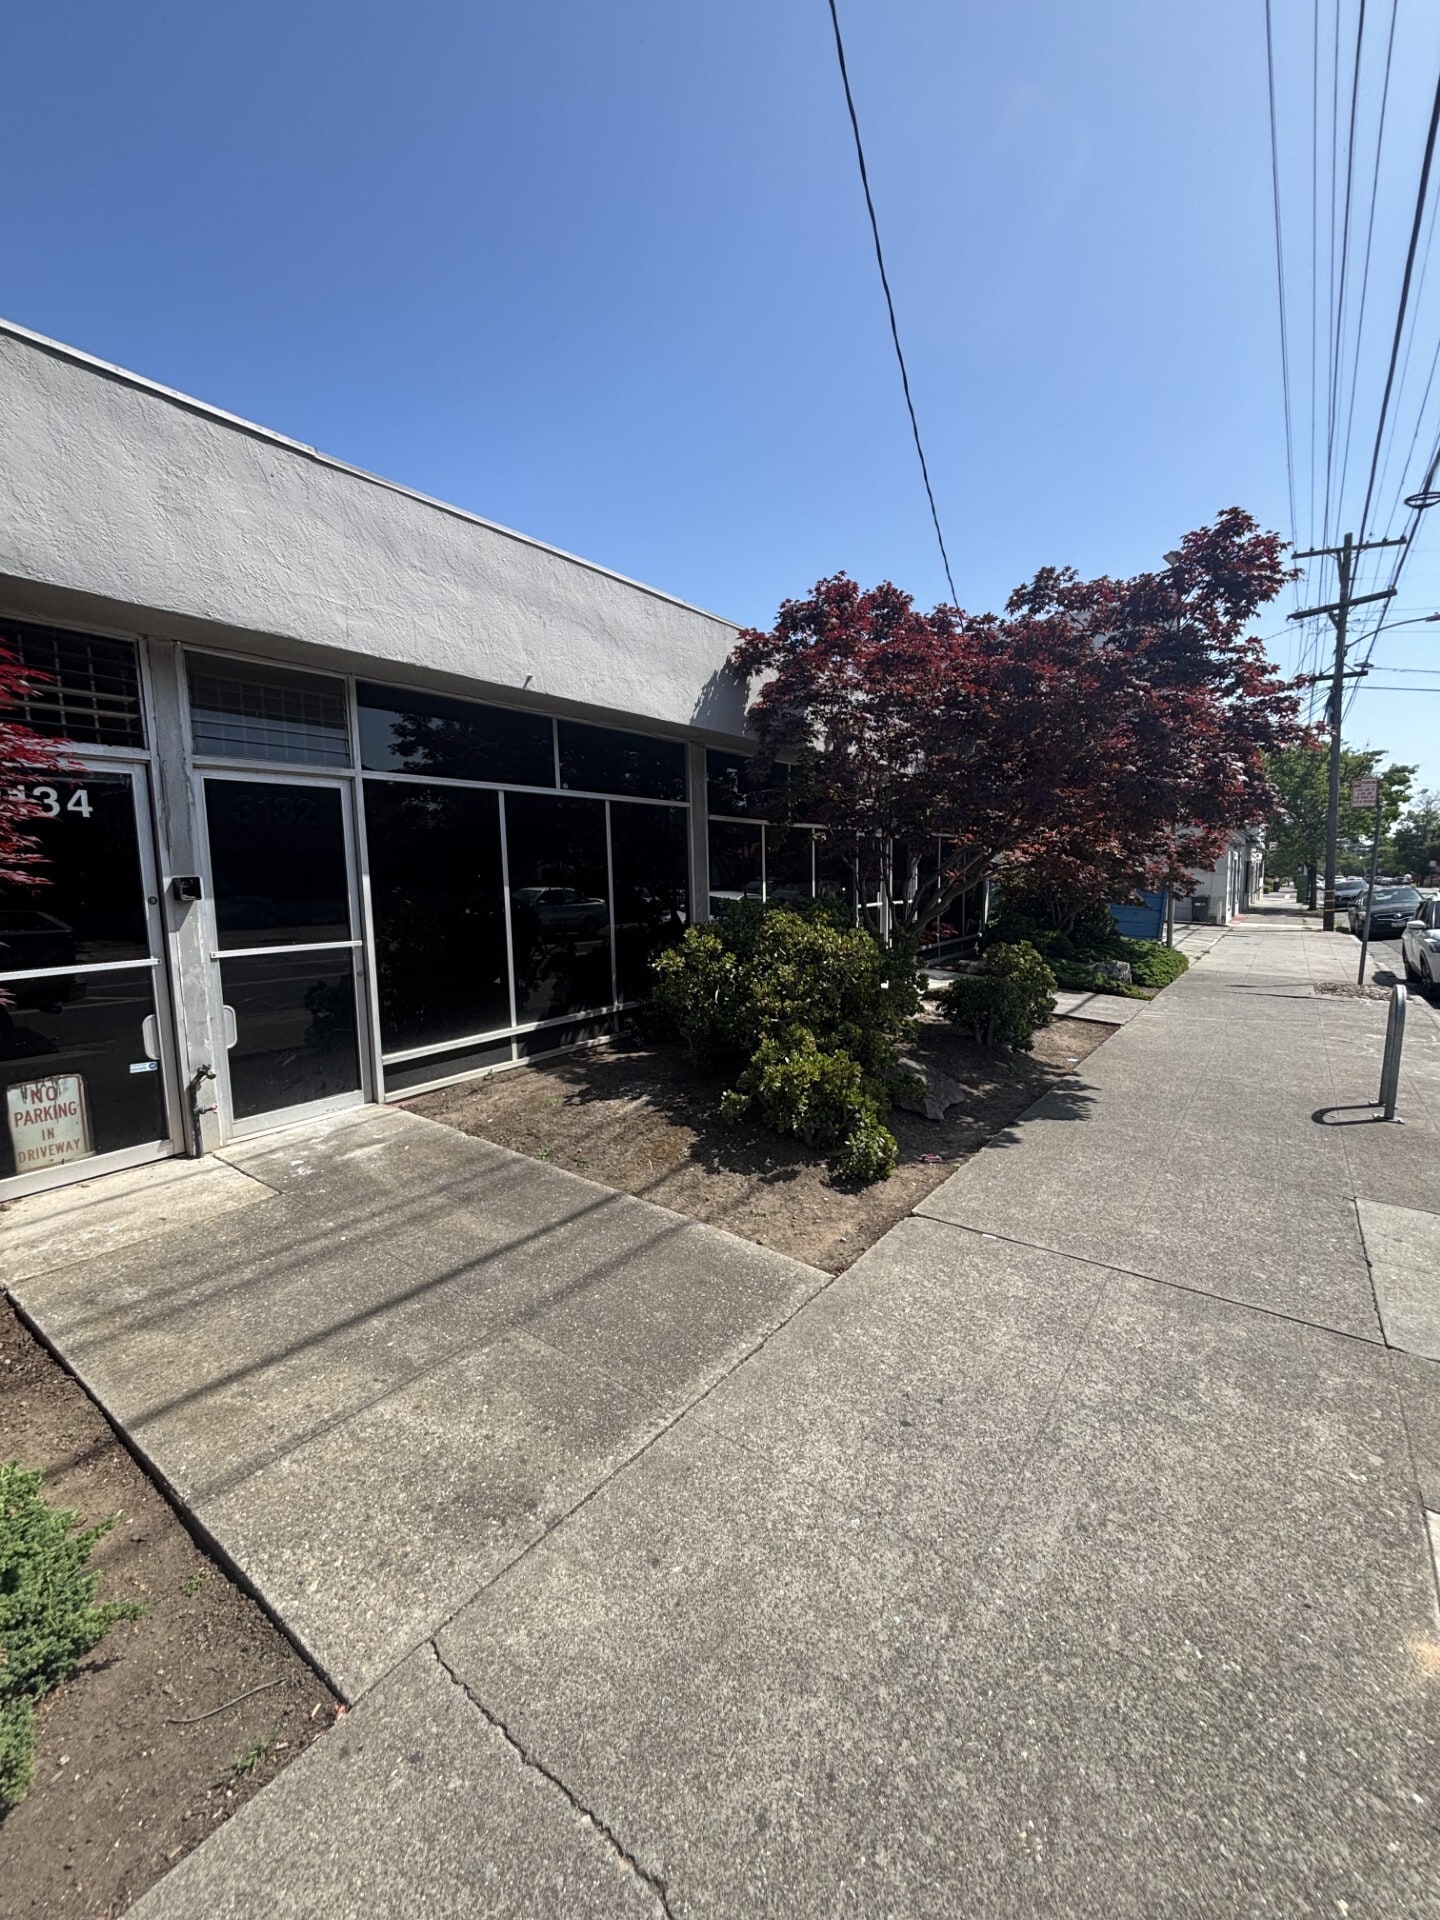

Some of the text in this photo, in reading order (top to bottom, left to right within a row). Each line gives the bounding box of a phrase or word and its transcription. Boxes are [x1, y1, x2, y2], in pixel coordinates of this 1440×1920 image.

[233, 794, 317, 825] 3132
[31, 1086, 58, 1105] NO
[14, 1101, 78, 1128] PARKING
[41, 1128, 55, 1141] IN
[18, 1138, 81, 1163] DRIVEWAY
